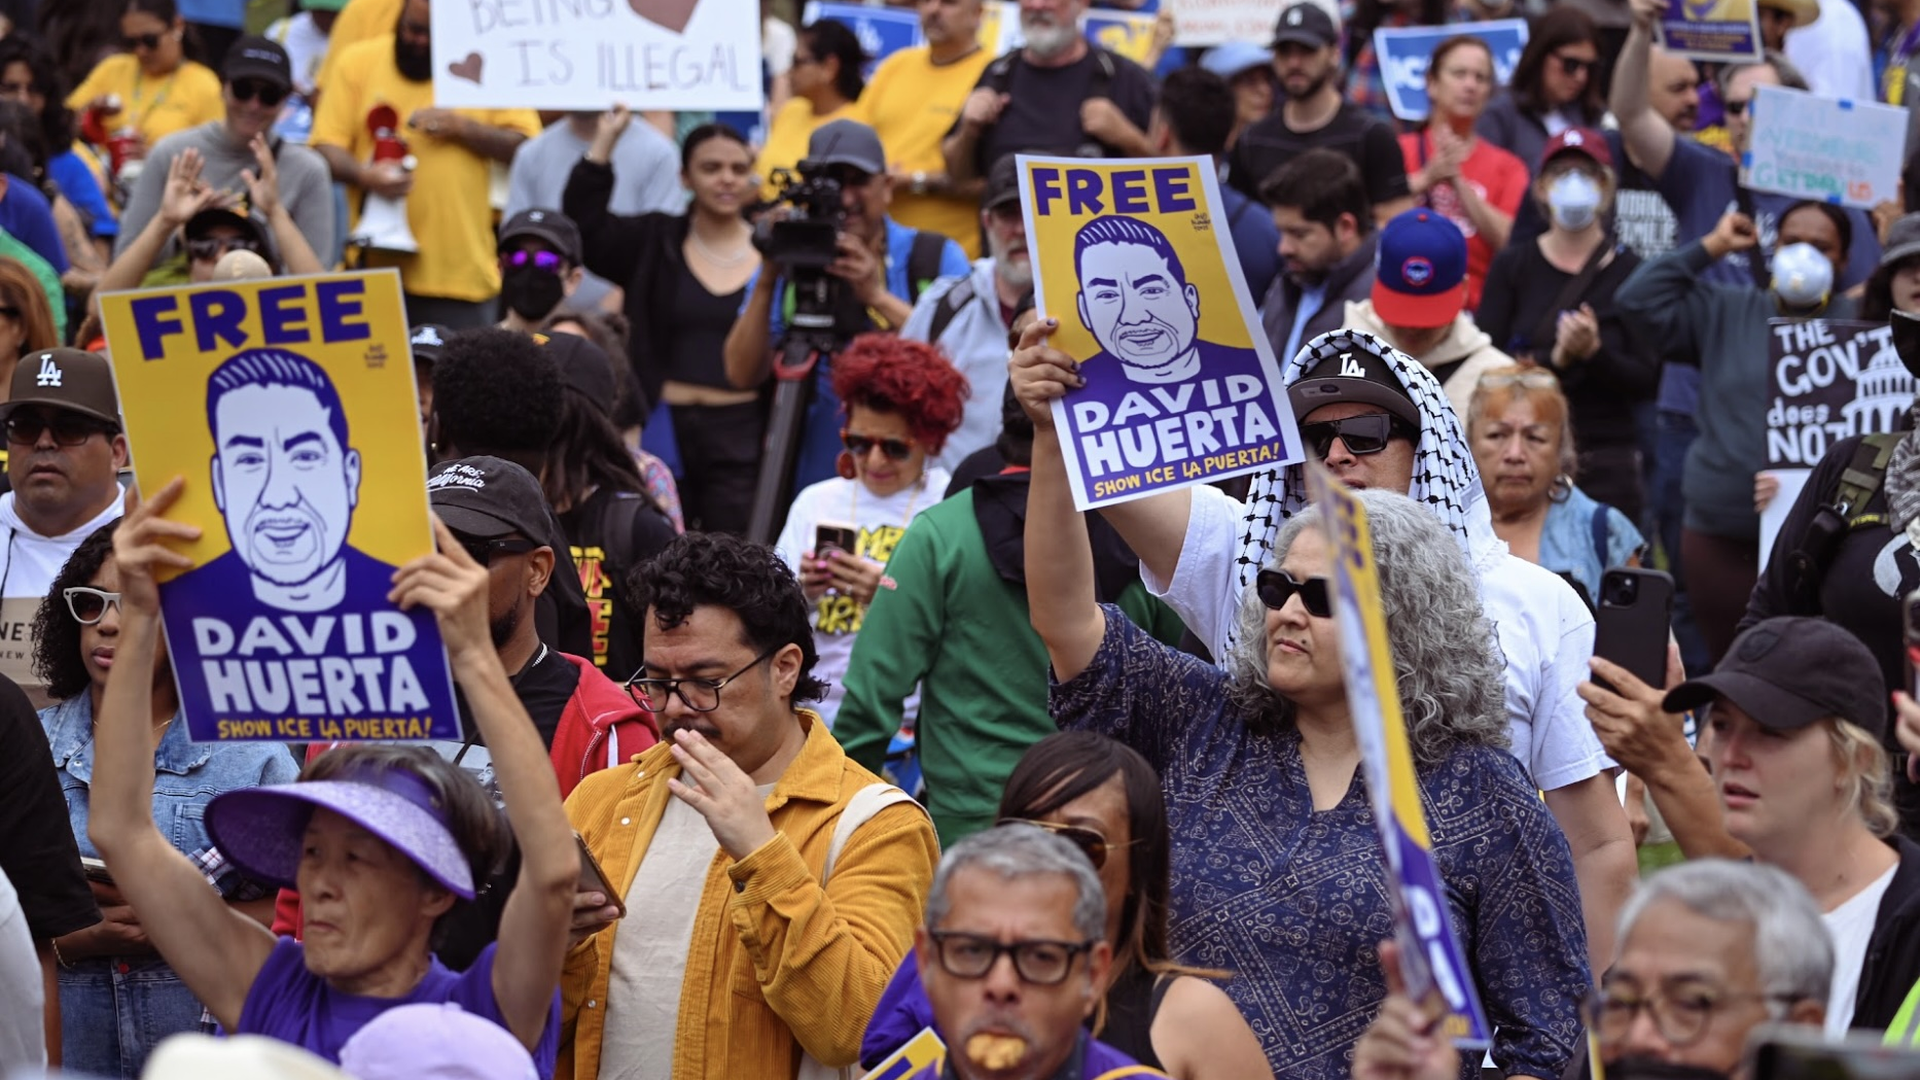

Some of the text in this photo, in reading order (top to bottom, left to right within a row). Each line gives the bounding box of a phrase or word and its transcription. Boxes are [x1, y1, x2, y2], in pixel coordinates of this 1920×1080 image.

[510, 40, 751, 92] IS ILLEGAL
[1031, 167, 1197, 216] FREE
[129, 279, 371, 361] FREE
[1774, 321, 1836, 353] THE
[37, 353, 62, 387] LA
[1338, 353, 1366, 378] LA
[1776, 326, 1892, 397] GOV'T
[1072, 374, 1264, 434] DAVID
[1767, 397, 1830, 428] does
[1081, 402, 1278, 478] HUERTA
[1094, 443, 1280, 498] SHOW ICE LA PUERTA!
[192, 610, 418, 657] DAVID
[201, 655, 431, 716] HUERTA
[217, 716, 432, 739] SHOW ICE LA PUERTA!
